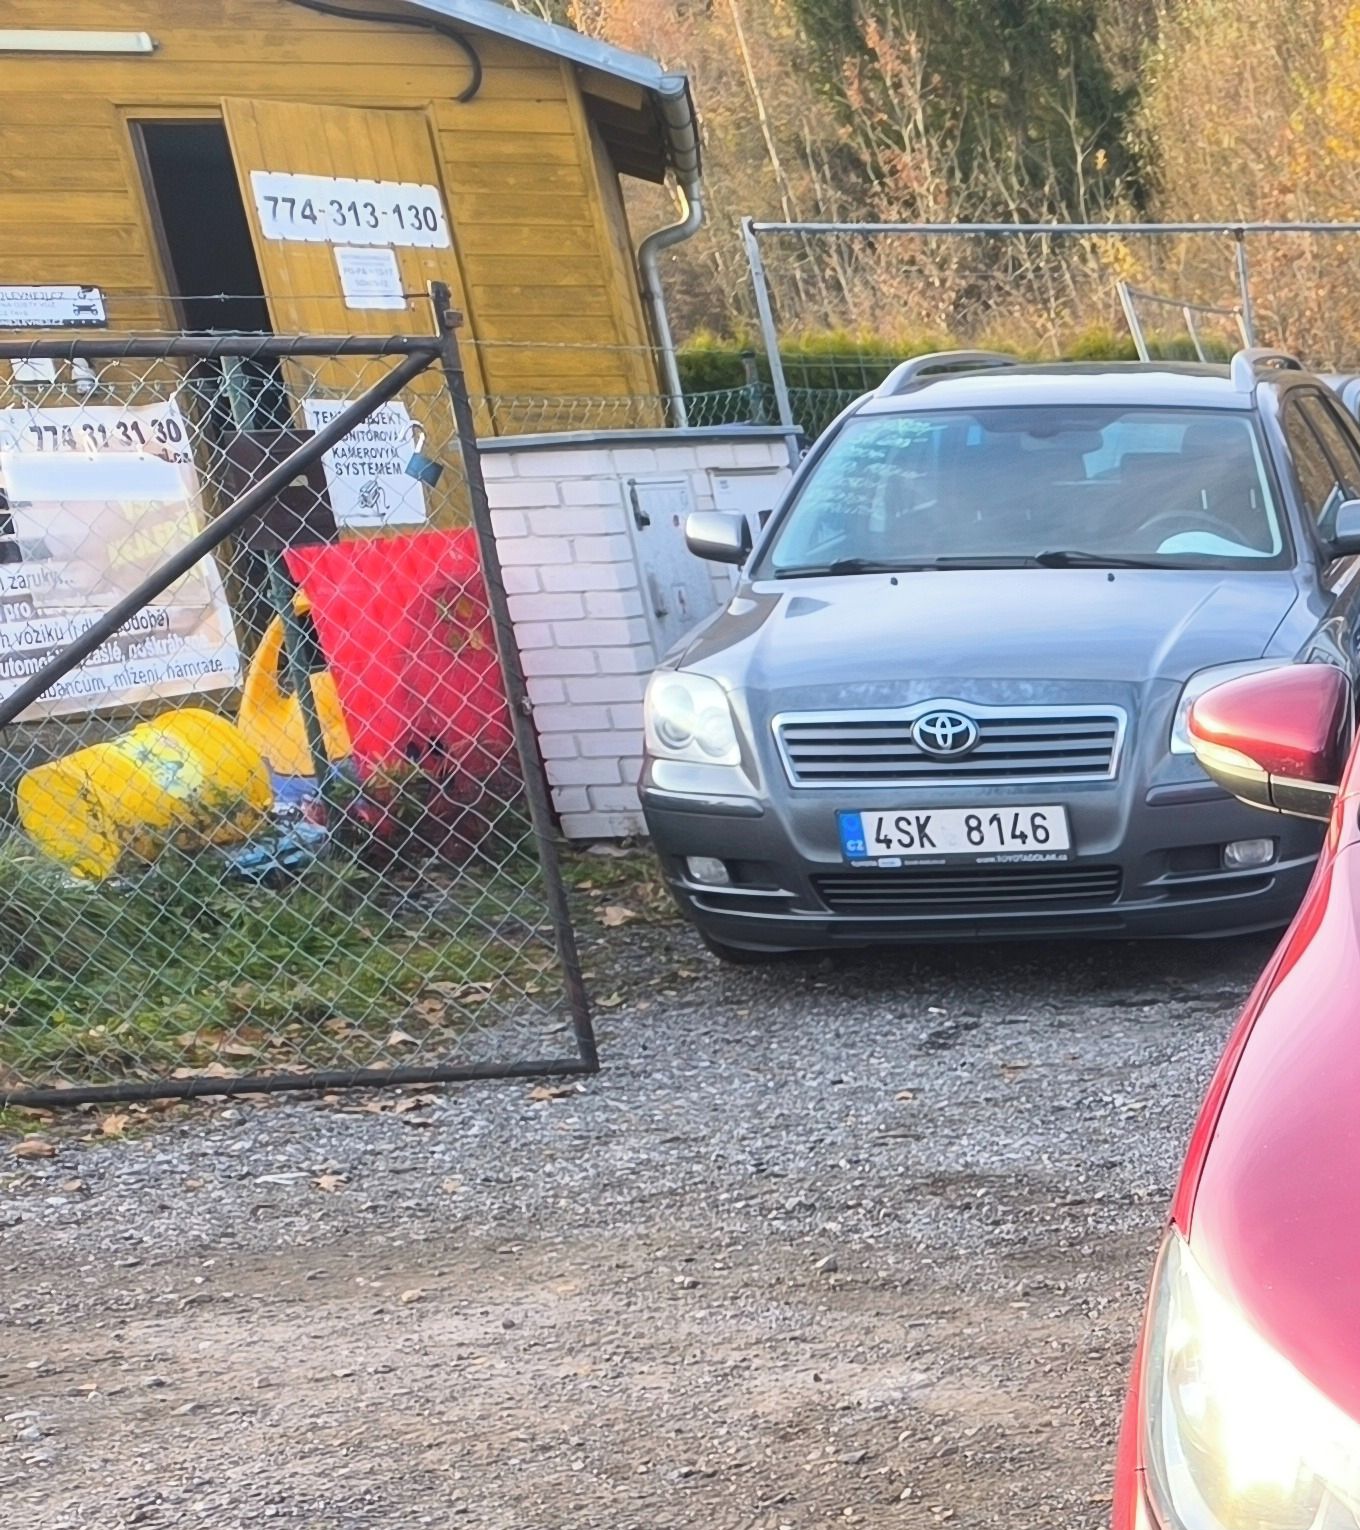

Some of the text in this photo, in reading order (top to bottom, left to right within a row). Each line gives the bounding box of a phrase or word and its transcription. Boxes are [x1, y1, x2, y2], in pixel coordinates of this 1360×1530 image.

[263, 195, 438, 232] 774-313-130
[846, 840, 865, 851] CZ
[874, 812, 1050, 849] 4SK 8146
